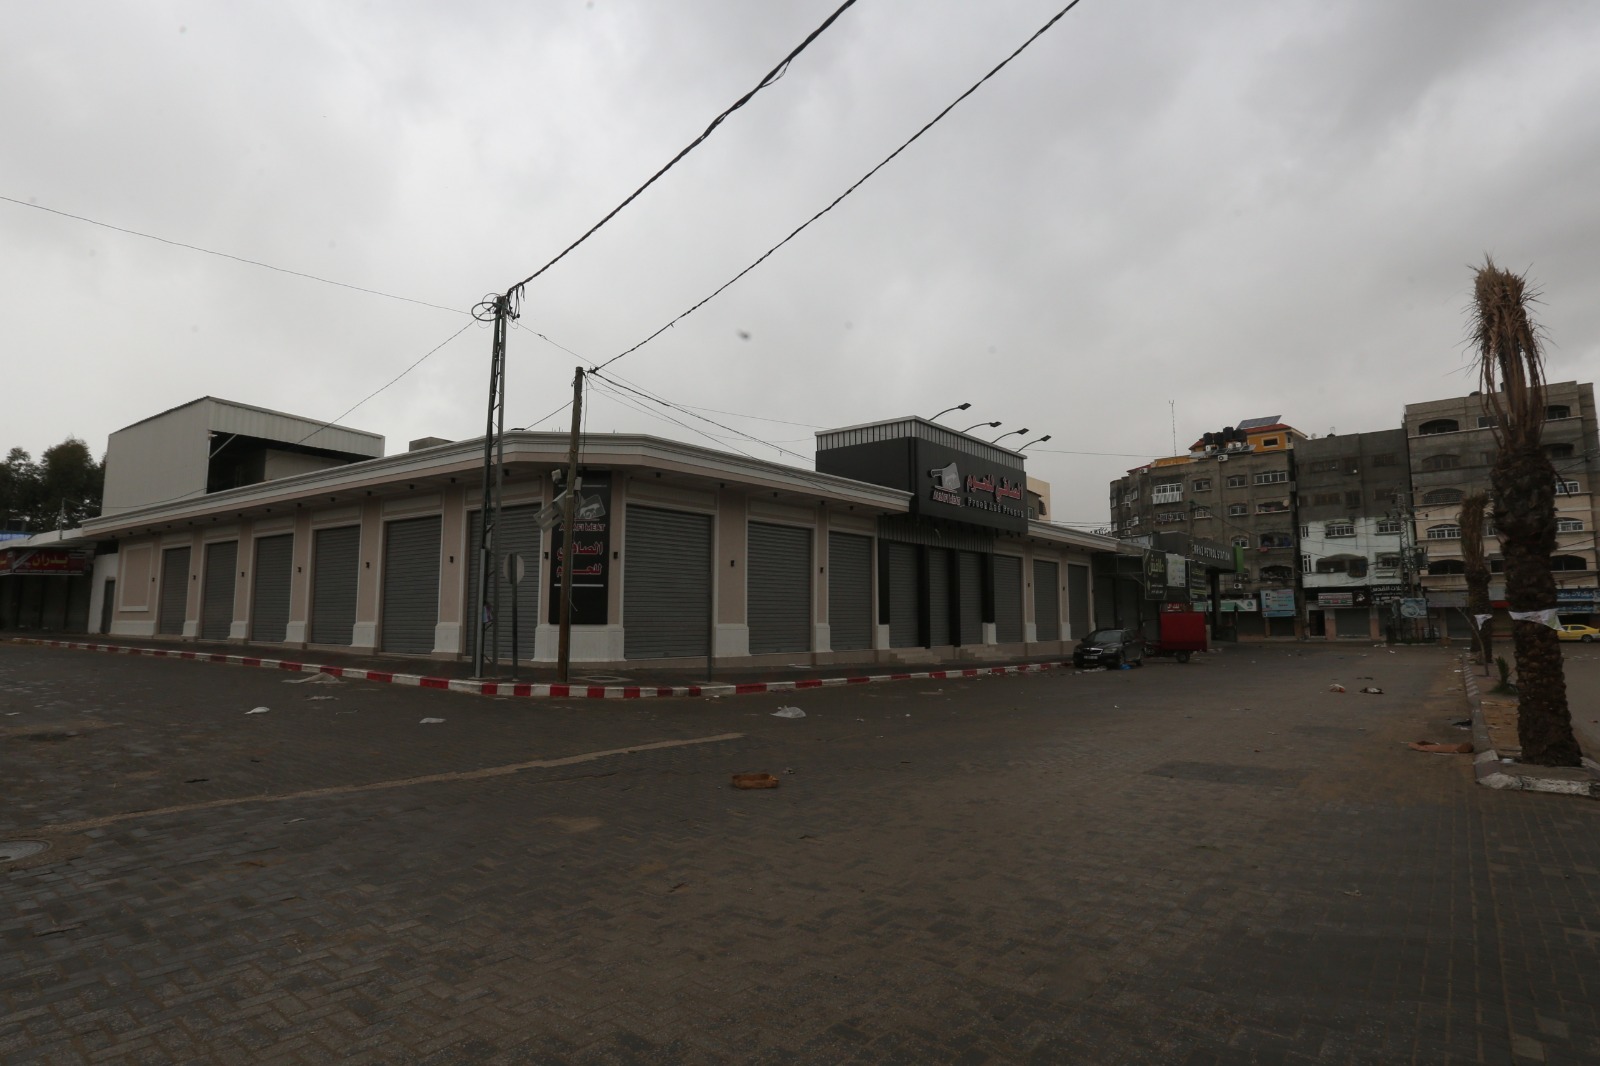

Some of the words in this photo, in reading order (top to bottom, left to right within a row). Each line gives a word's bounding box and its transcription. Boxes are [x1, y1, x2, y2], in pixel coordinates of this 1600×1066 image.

[988, 502, 1002, 513] And
[558, 522, 584, 532] AAFI
[585, 522, 606, 532] MEAT
